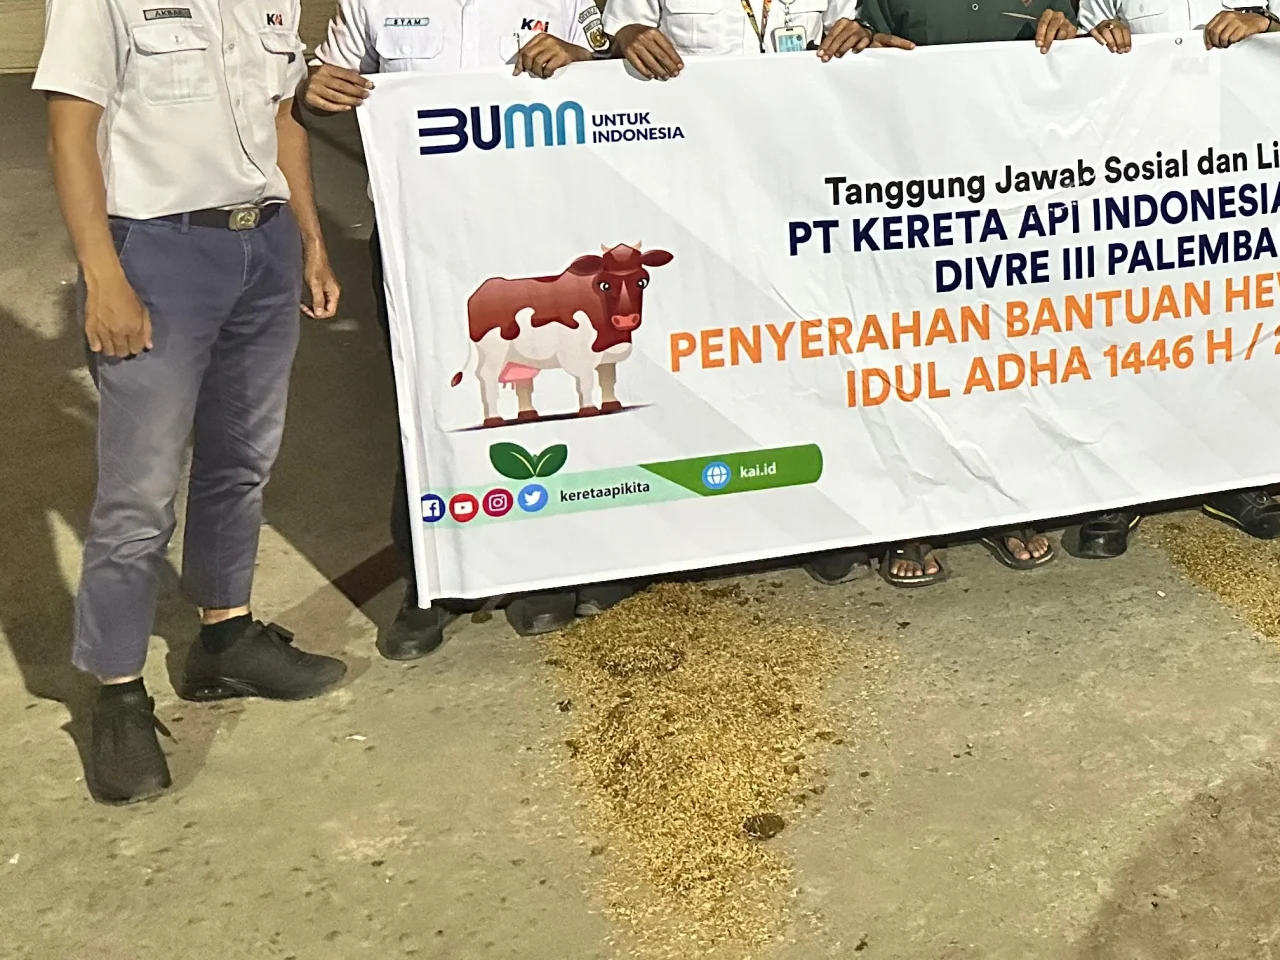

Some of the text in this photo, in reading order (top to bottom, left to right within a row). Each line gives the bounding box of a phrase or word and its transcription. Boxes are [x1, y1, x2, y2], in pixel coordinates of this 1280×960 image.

[393, 18, 422, 26] SYAM
[592, 112, 651, 128] UNTUK
[592, 126, 685, 144] INDONESIA
[825, 176, 985, 210] Tanggung
[996, 159, 1096, 194] Jawab
[1105, 150, 1189, 184] Sosial
[1198, 146, 1248, 176] dan
[788, 220, 840, 257] PT
[853, 208, 1009, 252] KERETA
[1018, 200, 1080, 239] API
[935, 249, 1050, 293] DIVRE
[1062, 245, 1095, 281] III
[669, 303, 991, 373] PENYERAHAN
[1005, 280, 1211, 339] BANTUAN
[846, 361, 951, 408] IDUL
[963, 345, 1092, 396] ADHA
[1102, 334, 1195, 378] 1446
[1206, 327, 1233, 365] H
[1244, 323, 1264, 361] /
[739, 462, 777, 478] kai.id
[560, 481, 651, 503] keretaapikita
